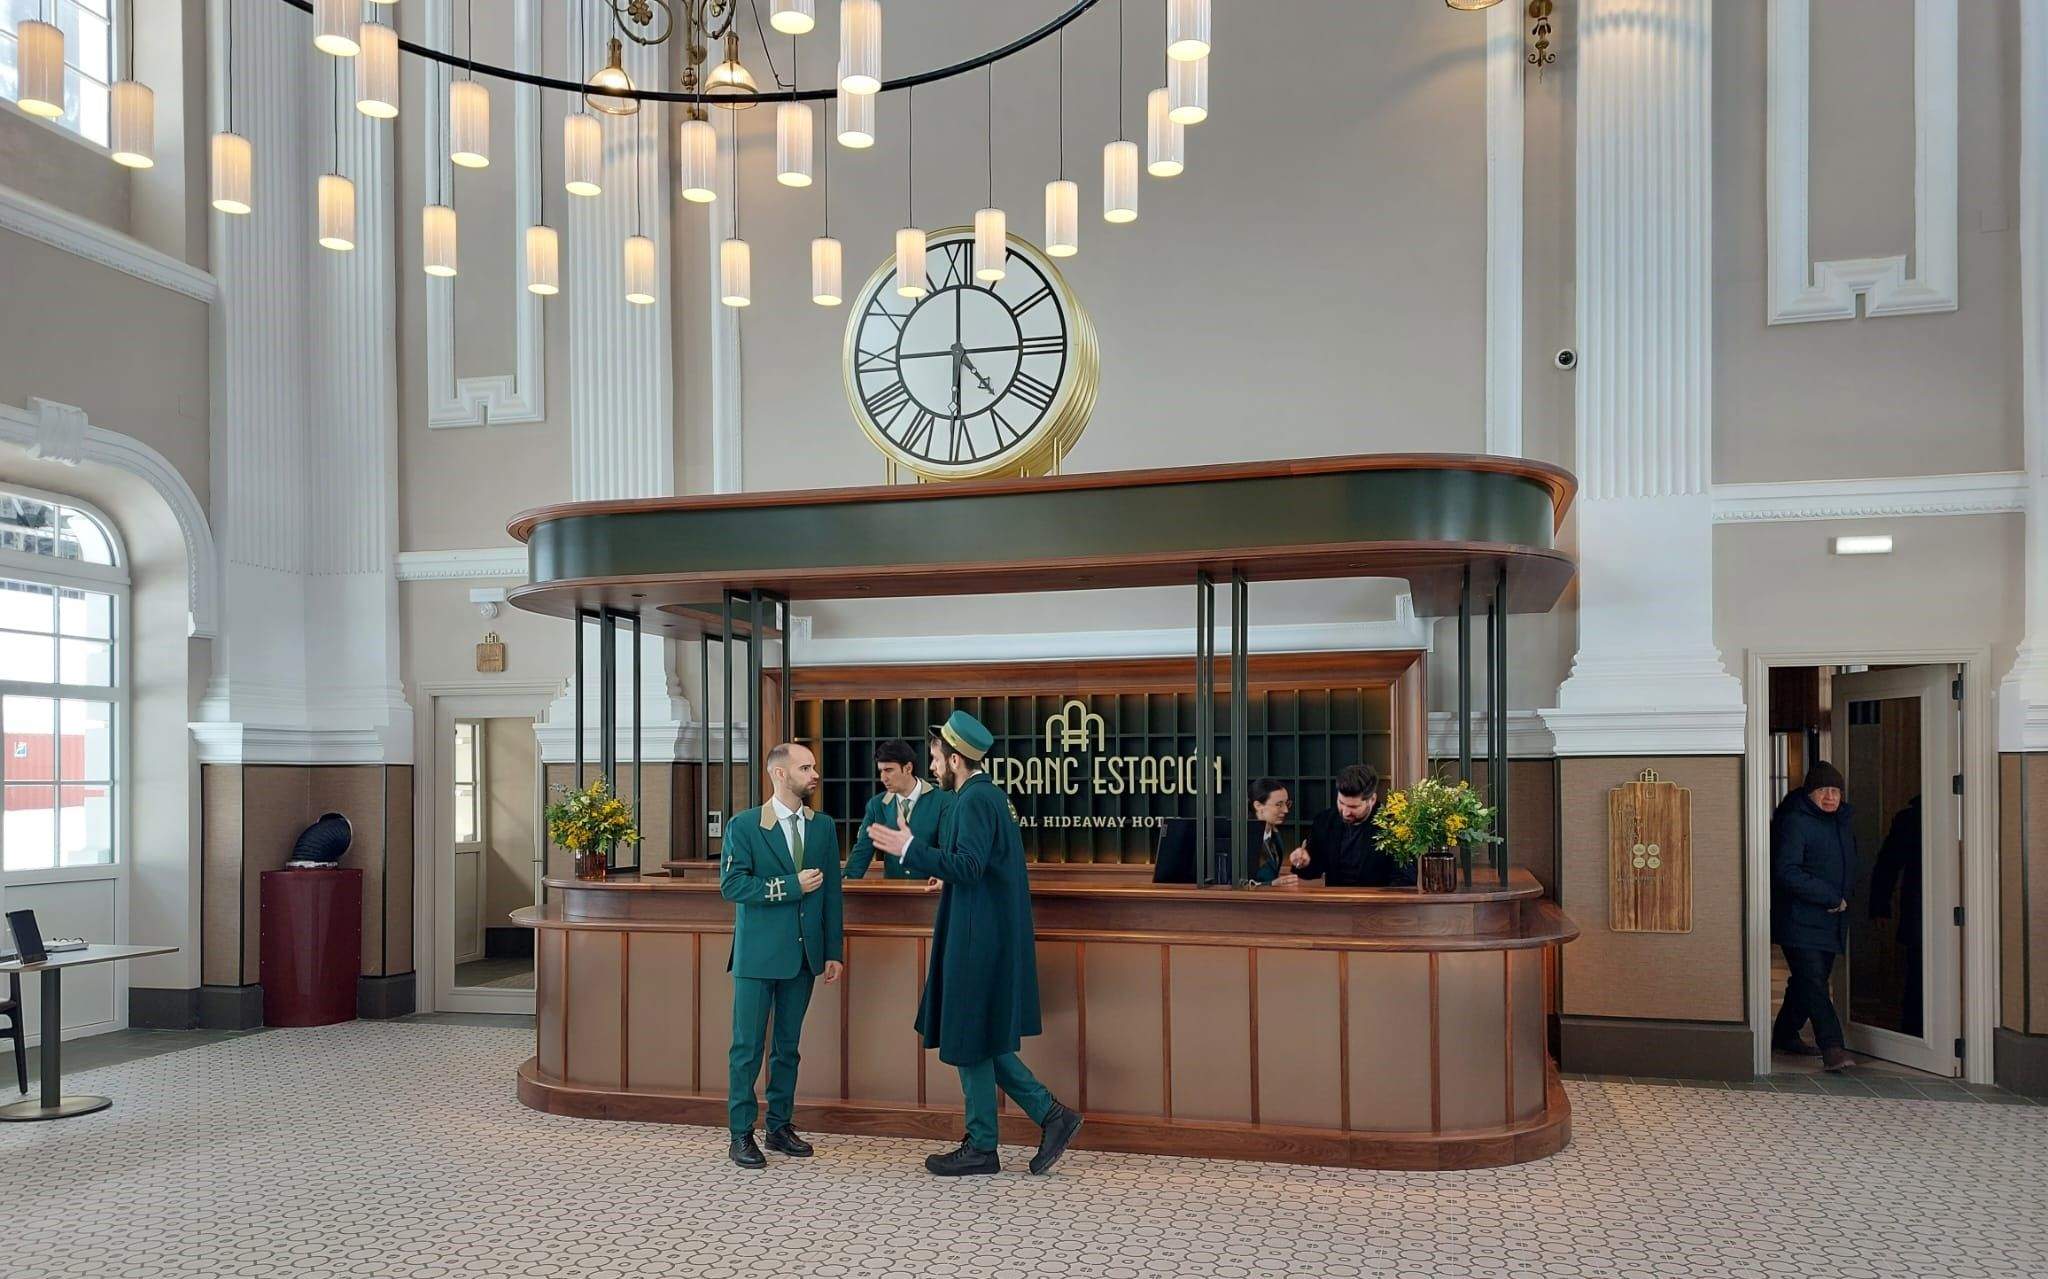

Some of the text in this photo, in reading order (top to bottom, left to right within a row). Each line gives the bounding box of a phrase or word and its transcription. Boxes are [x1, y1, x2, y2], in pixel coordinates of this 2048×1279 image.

[980, 756, 1079, 795] FRANC
[1019, 816, 1164, 828] AL HIDEAWAY HOT
